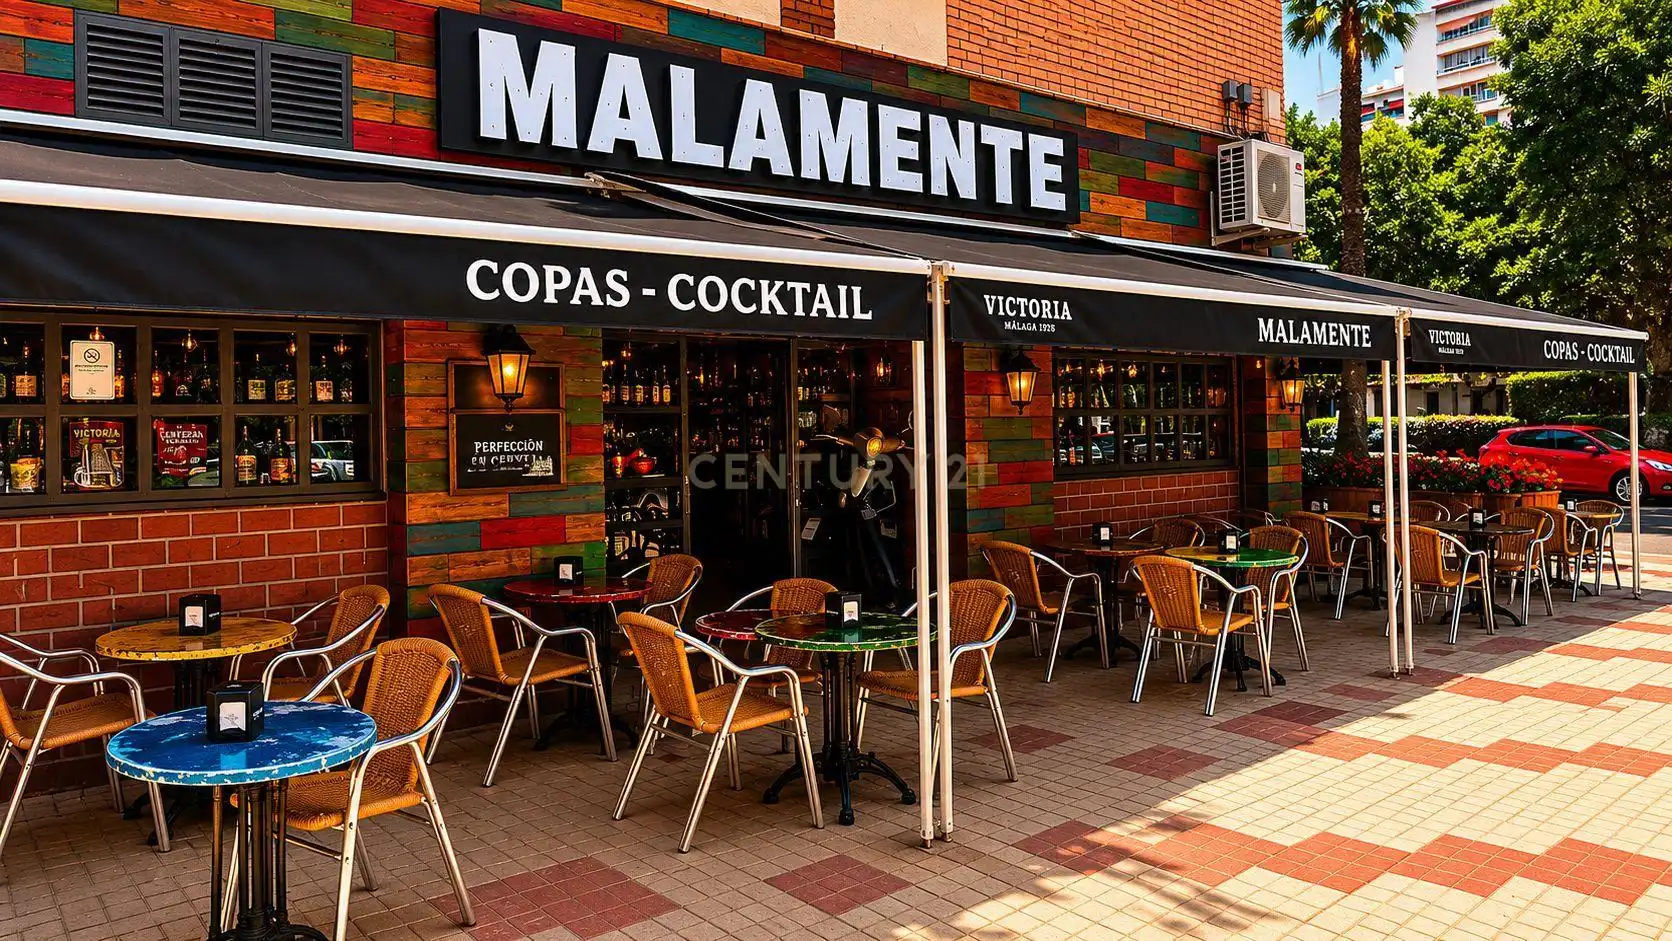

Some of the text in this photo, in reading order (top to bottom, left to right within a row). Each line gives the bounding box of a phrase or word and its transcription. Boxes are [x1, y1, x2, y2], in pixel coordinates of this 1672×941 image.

[478, 28, 1067, 212] MALAMENTE
[466, 259, 873, 321] COPAS - COCKTAIL
[983, 294, 1073, 321] VICTORIA
[1257, 317, 1372, 348] MALAMENTE
[1428, 329, 1472, 347] VICTORIA
[1543, 339, 1579, 361] COPAS
[1587, 343, 1635, 364] COCKTAIL
[73, 427, 121, 438] VICTORIA
